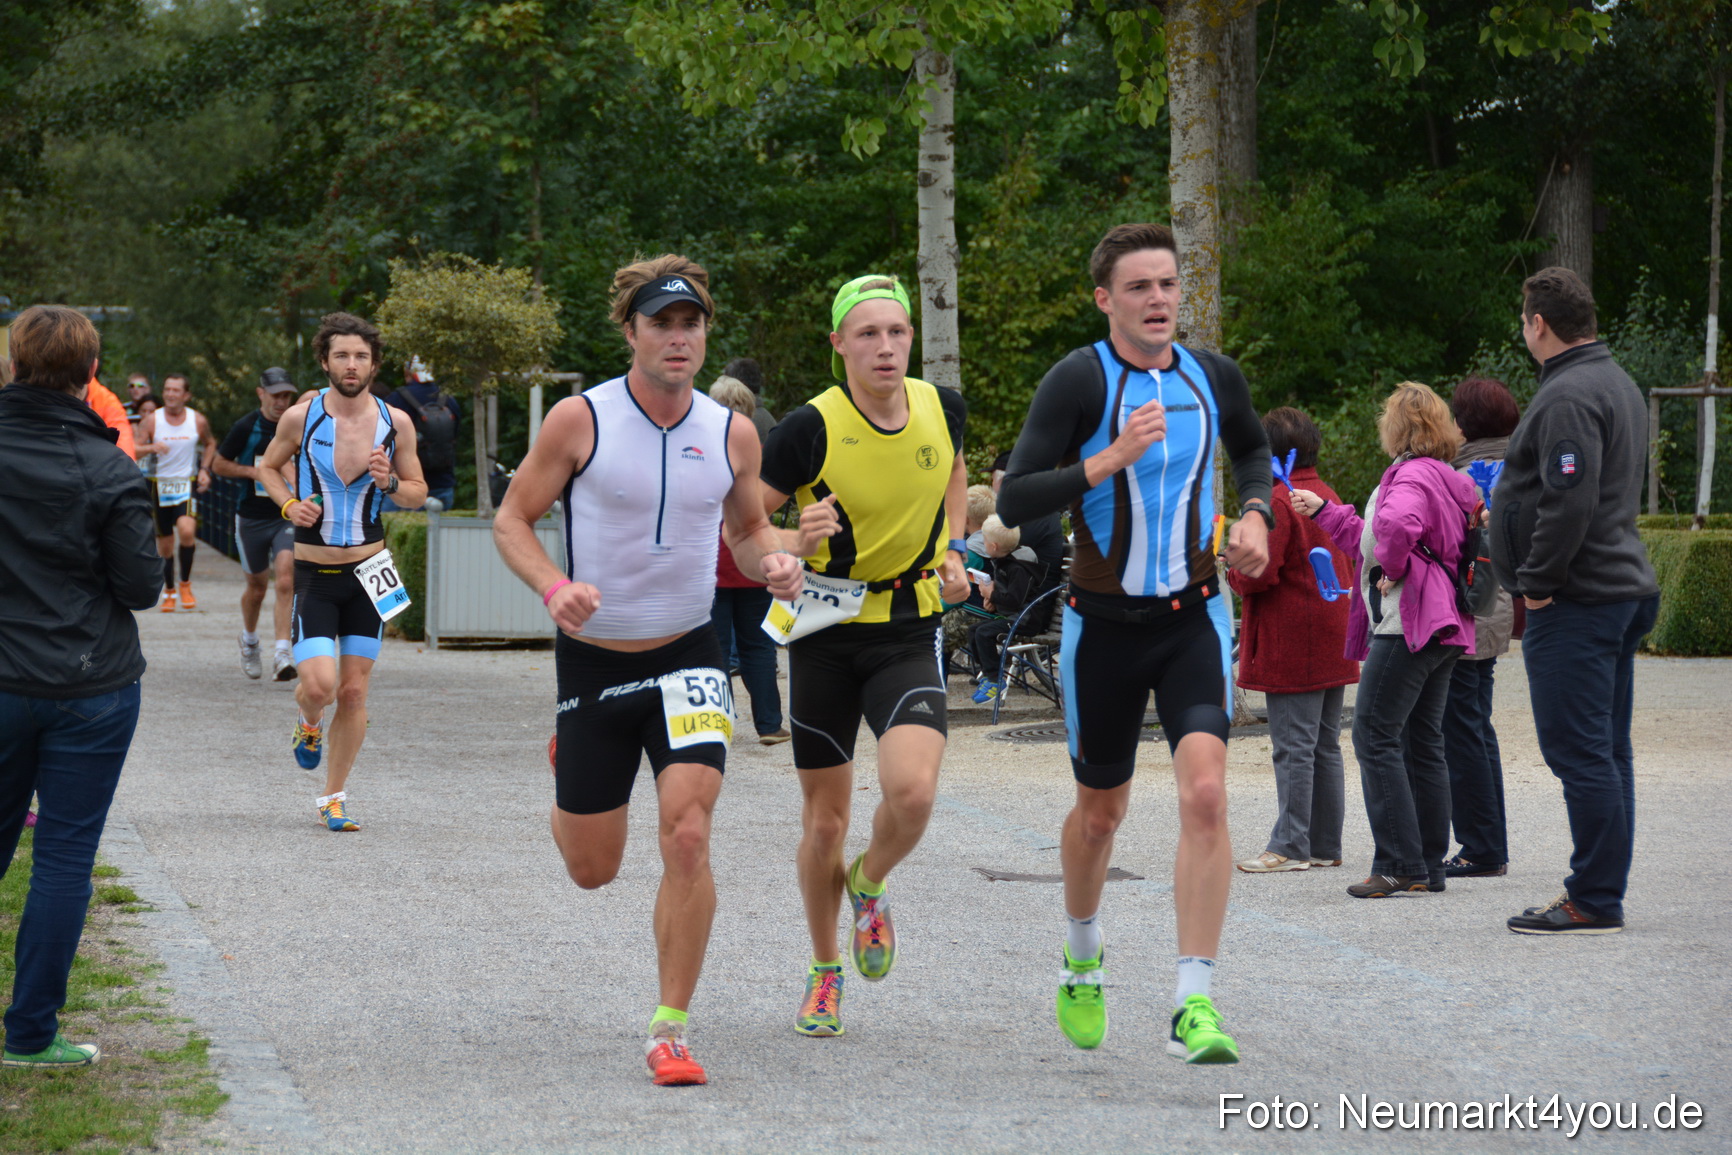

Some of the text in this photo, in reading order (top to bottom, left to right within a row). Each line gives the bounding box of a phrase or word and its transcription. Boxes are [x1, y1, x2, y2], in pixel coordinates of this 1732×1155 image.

[681, 453, 705, 461] skinfit
[369, 562, 398, 597] 20
[804, 575, 849, 593] Neumarkt
